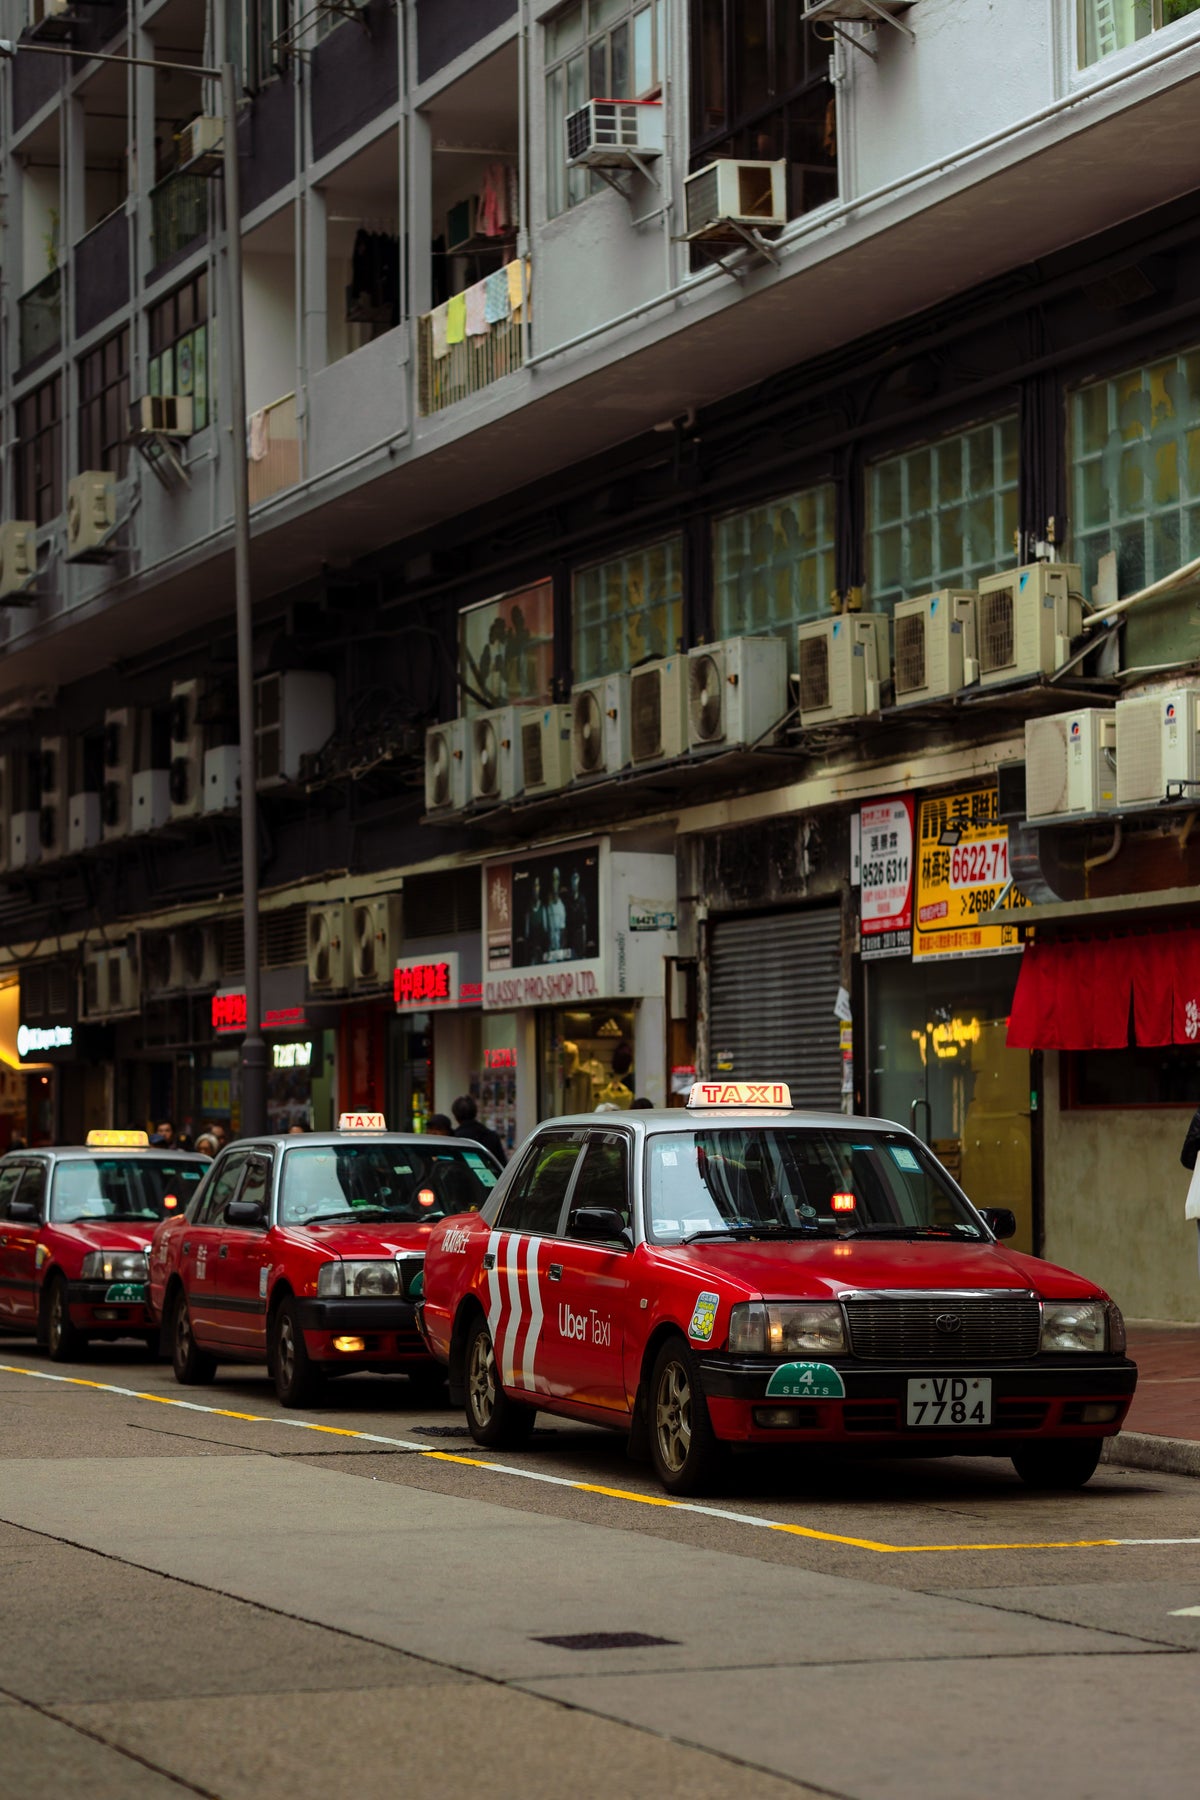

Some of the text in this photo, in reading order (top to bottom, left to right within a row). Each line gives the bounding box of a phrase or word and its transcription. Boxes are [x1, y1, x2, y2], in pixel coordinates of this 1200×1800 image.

[863, 856, 908, 888] 9526 6311
[486, 978, 522, 1006] CLASSIC
[525, 972, 574, 1001] PRO-SHOP
[702, 1086, 783, 1103] TAXI
[346, 1116, 381, 1127] TAXI
[558, 1302, 611, 1347] Uber Taxi
[799, 1370, 814, 1386] 4
[783, 1386, 829, 1395] SEATS
[932, 1378, 967, 1402] VD
[913, 1401, 985, 1424] 7784
